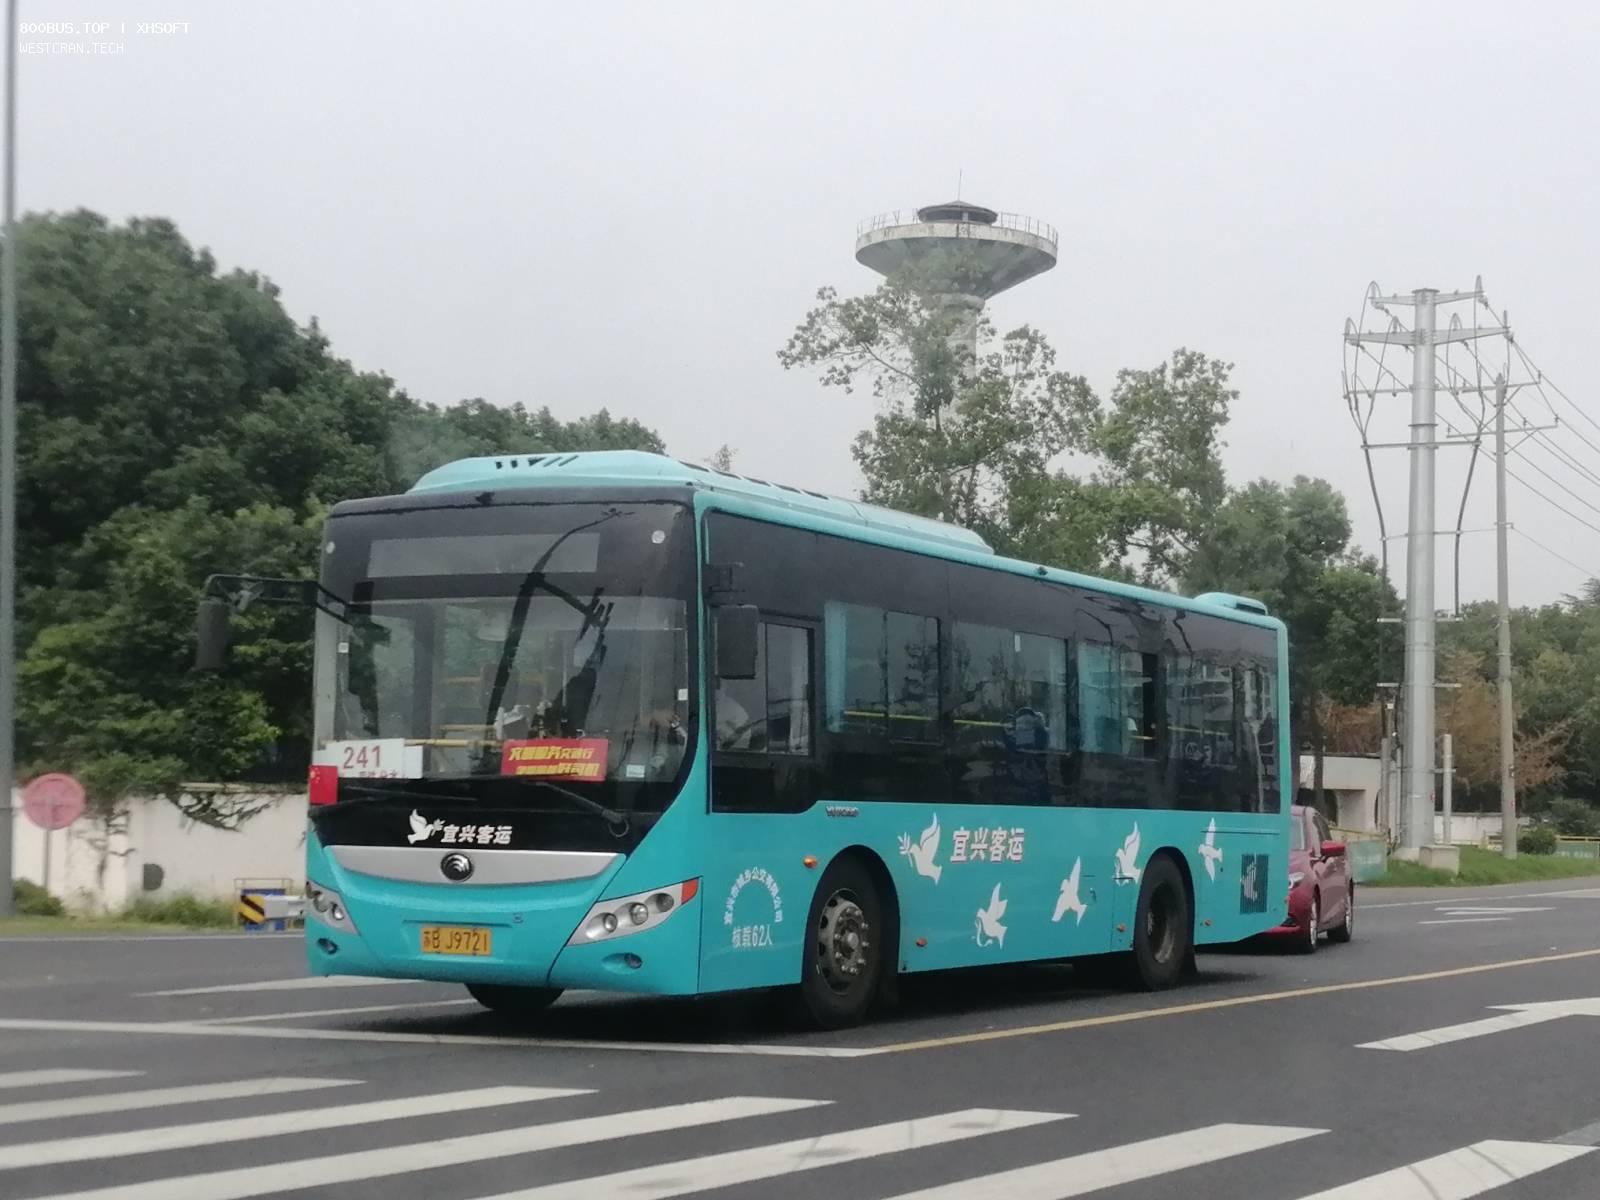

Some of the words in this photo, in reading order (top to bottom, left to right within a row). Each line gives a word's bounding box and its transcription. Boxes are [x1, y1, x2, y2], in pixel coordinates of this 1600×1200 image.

[343, 745, 381, 769] 241
[440, 824, 513, 845] 宜兴客运
[950, 826, 1025, 863] 宜兴客运
